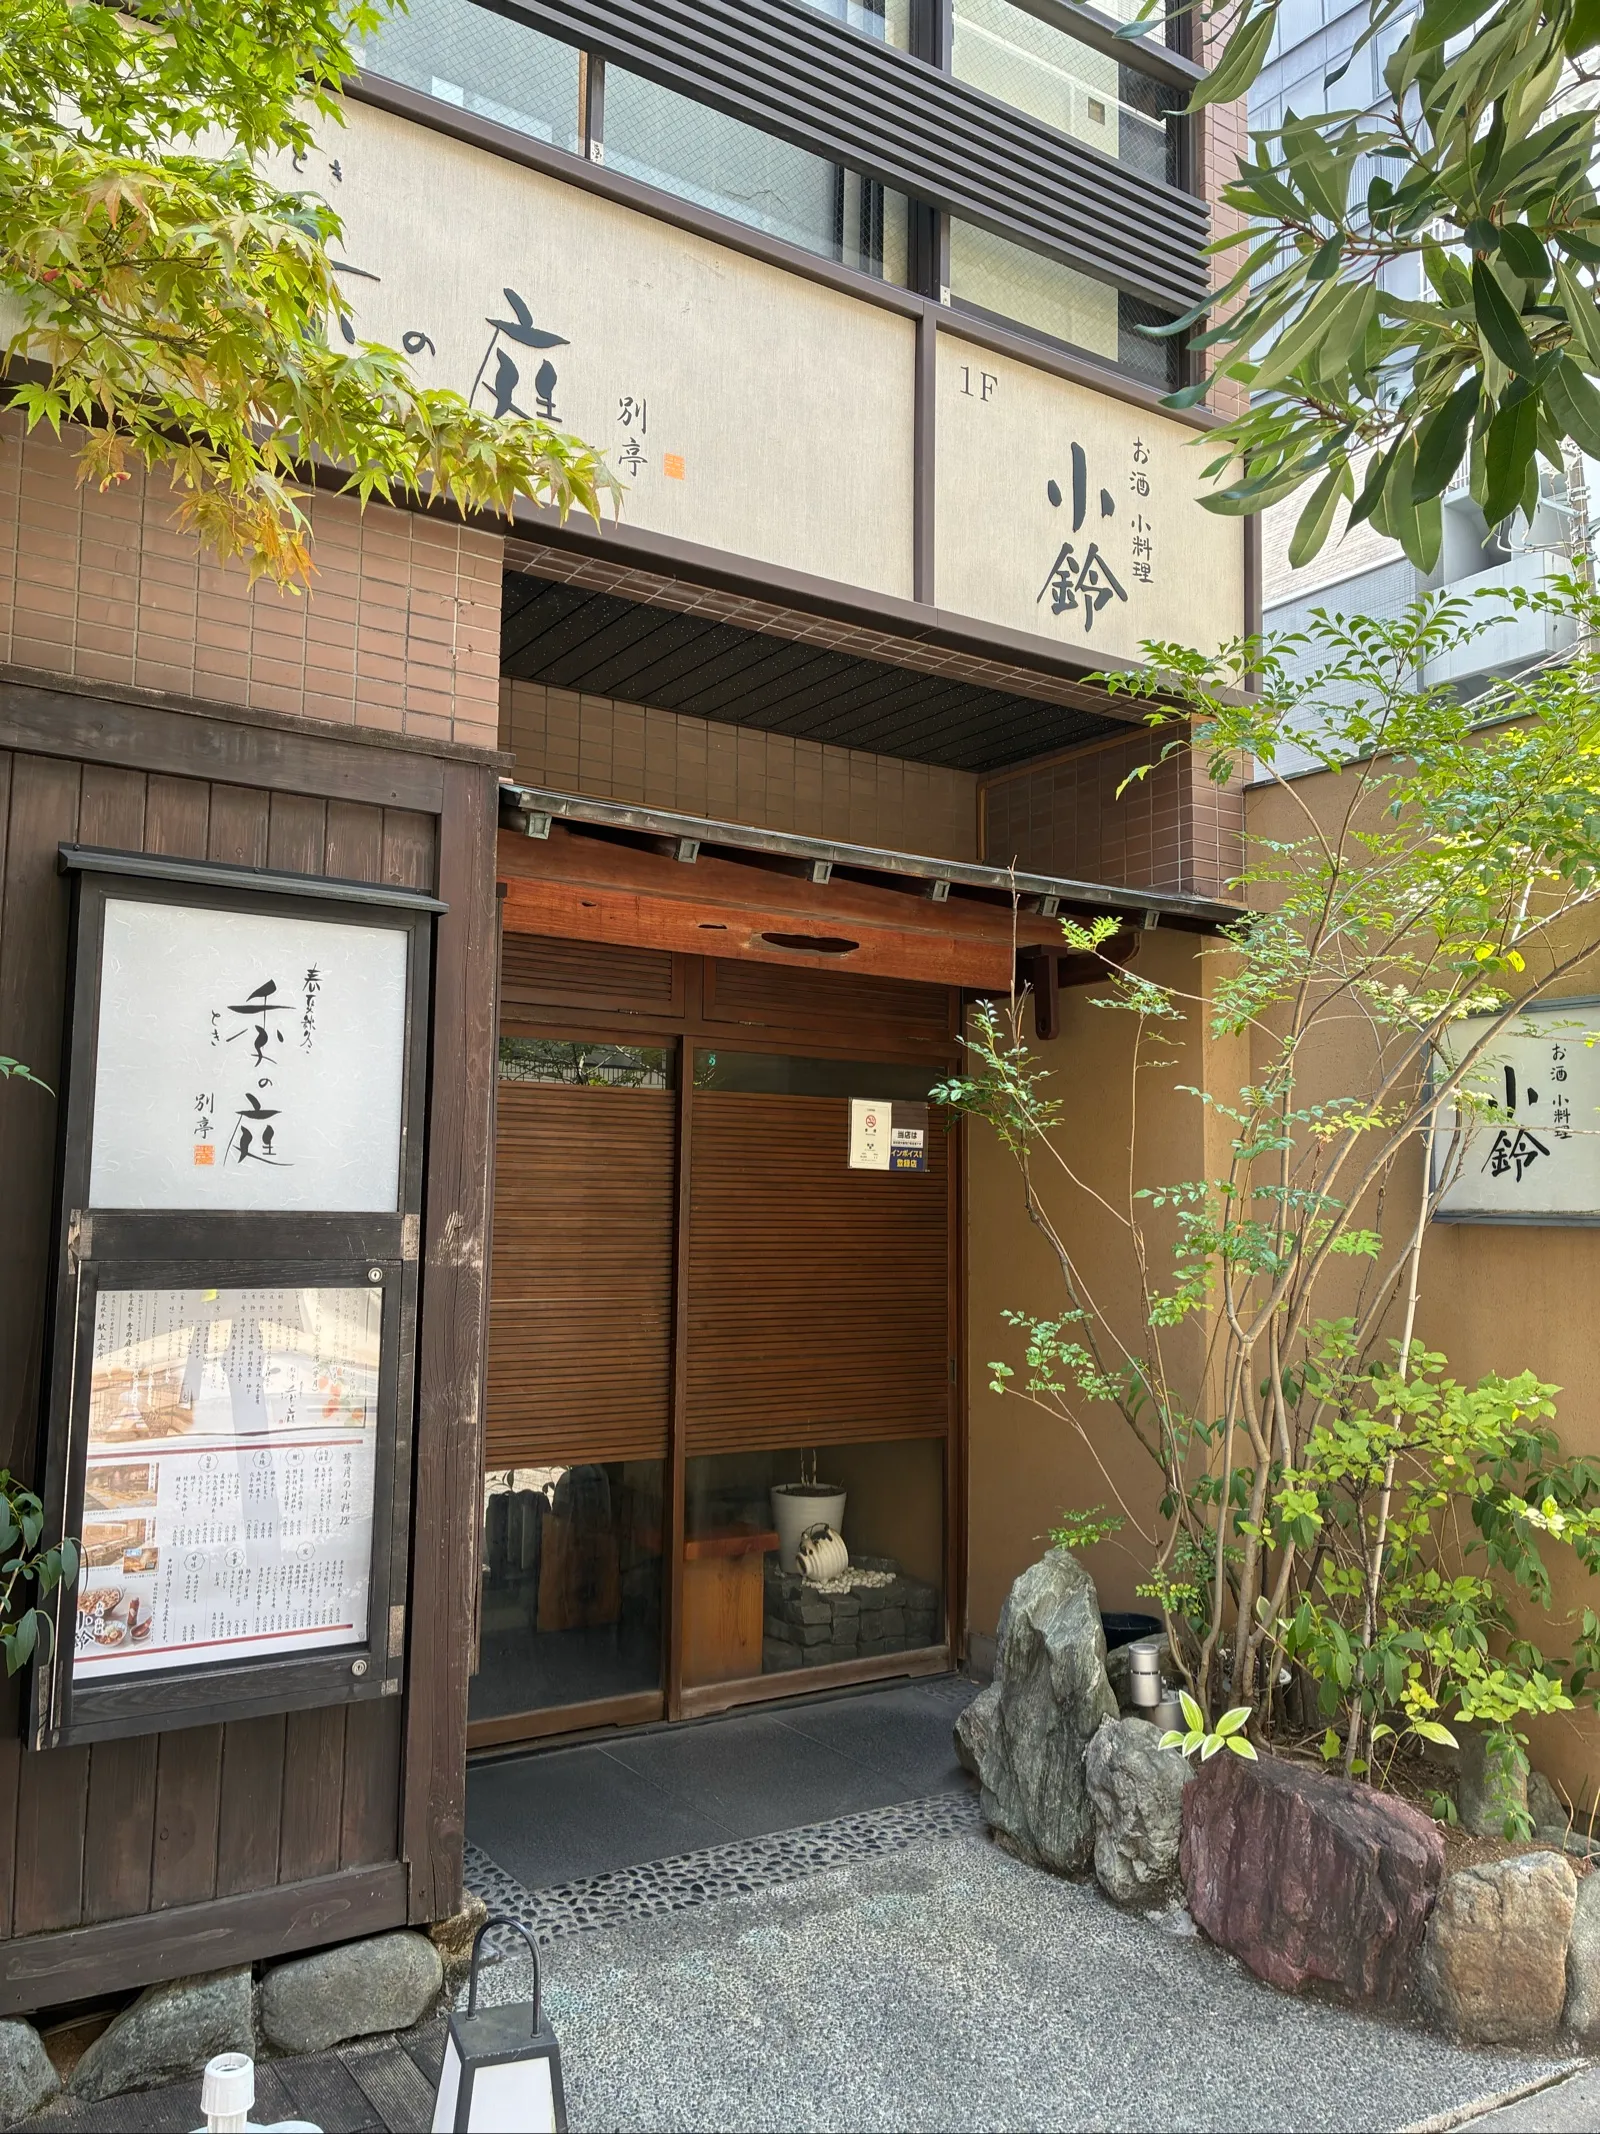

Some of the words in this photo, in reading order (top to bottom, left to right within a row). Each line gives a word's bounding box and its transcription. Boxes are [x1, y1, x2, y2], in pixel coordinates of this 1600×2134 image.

[301, 222, 571, 423] の庭
[959, 366, 999, 403] 1F
[616, 394, 649, 479] 別亭
[1129, 437, 1150, 498] お酒
[1036, 441, 1129, 633] 小鈴
[1130, 513, 1155, 585] 小料理
[1550, 1043, 1568, 1082] お酒
[193, 1092, 215, 1140] 別亭
[897, 1130, 918, 1140] 当店は
[1481, 1064, 1551, 1183] 小鈴
[1552, 1094, 1573, 1140] 小料理
